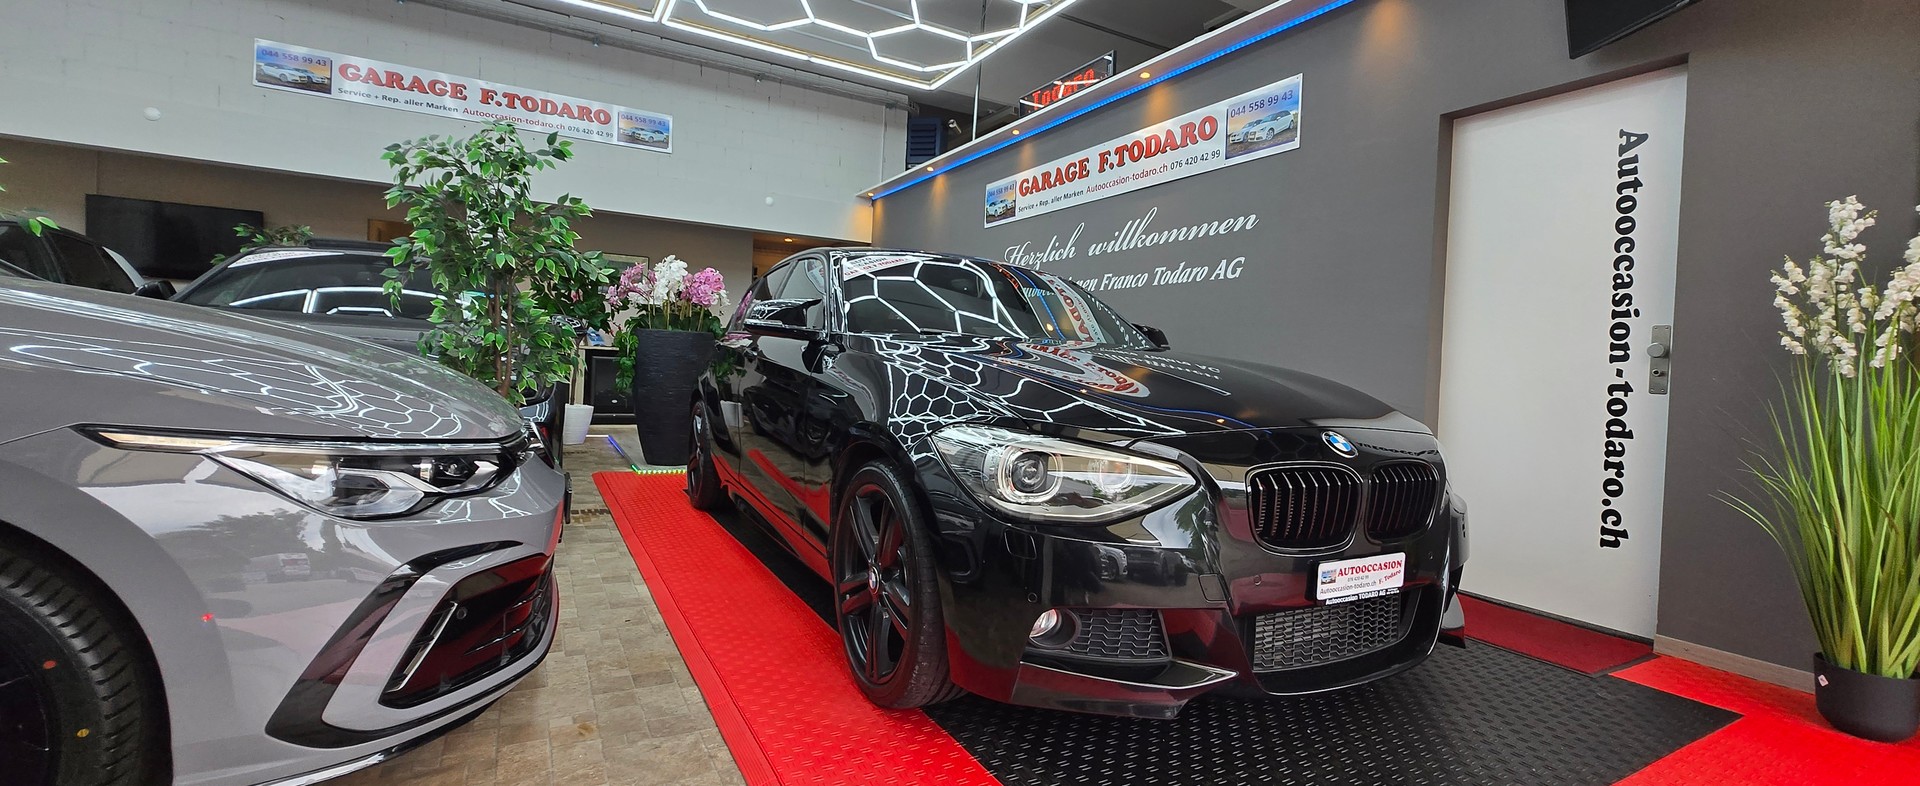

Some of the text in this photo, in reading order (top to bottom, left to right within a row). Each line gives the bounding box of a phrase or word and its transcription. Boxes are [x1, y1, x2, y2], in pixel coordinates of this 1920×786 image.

[261, 48, 279, 58] 044
[282, 52, 299, 61] 558
[315, 59, 327, 67] 43
[338, 63, 612, 126] GARAGE F.TODARO
[338, 87, 372, 99] Service
[381, 94, 401, 104] Rep.
[403, 98, 424, 107] aller
[425, 101, 459, 113] Marken
[462, 107, 566, 130] Autooccasion-todaro.ch
[567, 125, 580, 133] 076
[581, 127, 595, 135] 420
[604, 131, 614, 139] 99
[1230, 89, 1294, 118] 044 558 99 43
[1018, 115, 1219, 197] GARAGE F.TODARO
[1018, 204, 1035, 213] Service
[1039, 199, 1050, 208] Rep.
[1050, 195, 1063, 204] aller
[1063, 189, 1084, 201] Marken
[1086, 162, 1168, 195] Autooccasion-todaro.ch
[1170, 160, 1183, 171] 076
[1184, 155, 1198, 167] 420
[1199, 151, 1209, 162] 42
[1211, 149, 1221, 160] 99
[1004, 206, 1260, 271] Herzlich willkommen
[1099, 271, 1149, 292] Franco
[1151, 261, 1208, 287] Todaro
[1209, 256, 1246, 281] AG
[1599, 128, 1650, 550] Autooccasion-todaro.ch
[1320, 580, 1377, 595] Autooccasion-todaro.ch
[1337, 559, 1403, 577] AUTOOCCASION
[1325, 594, 1358, 606] Autooccasion
[1358, 590, 1378, 600] TODARO
